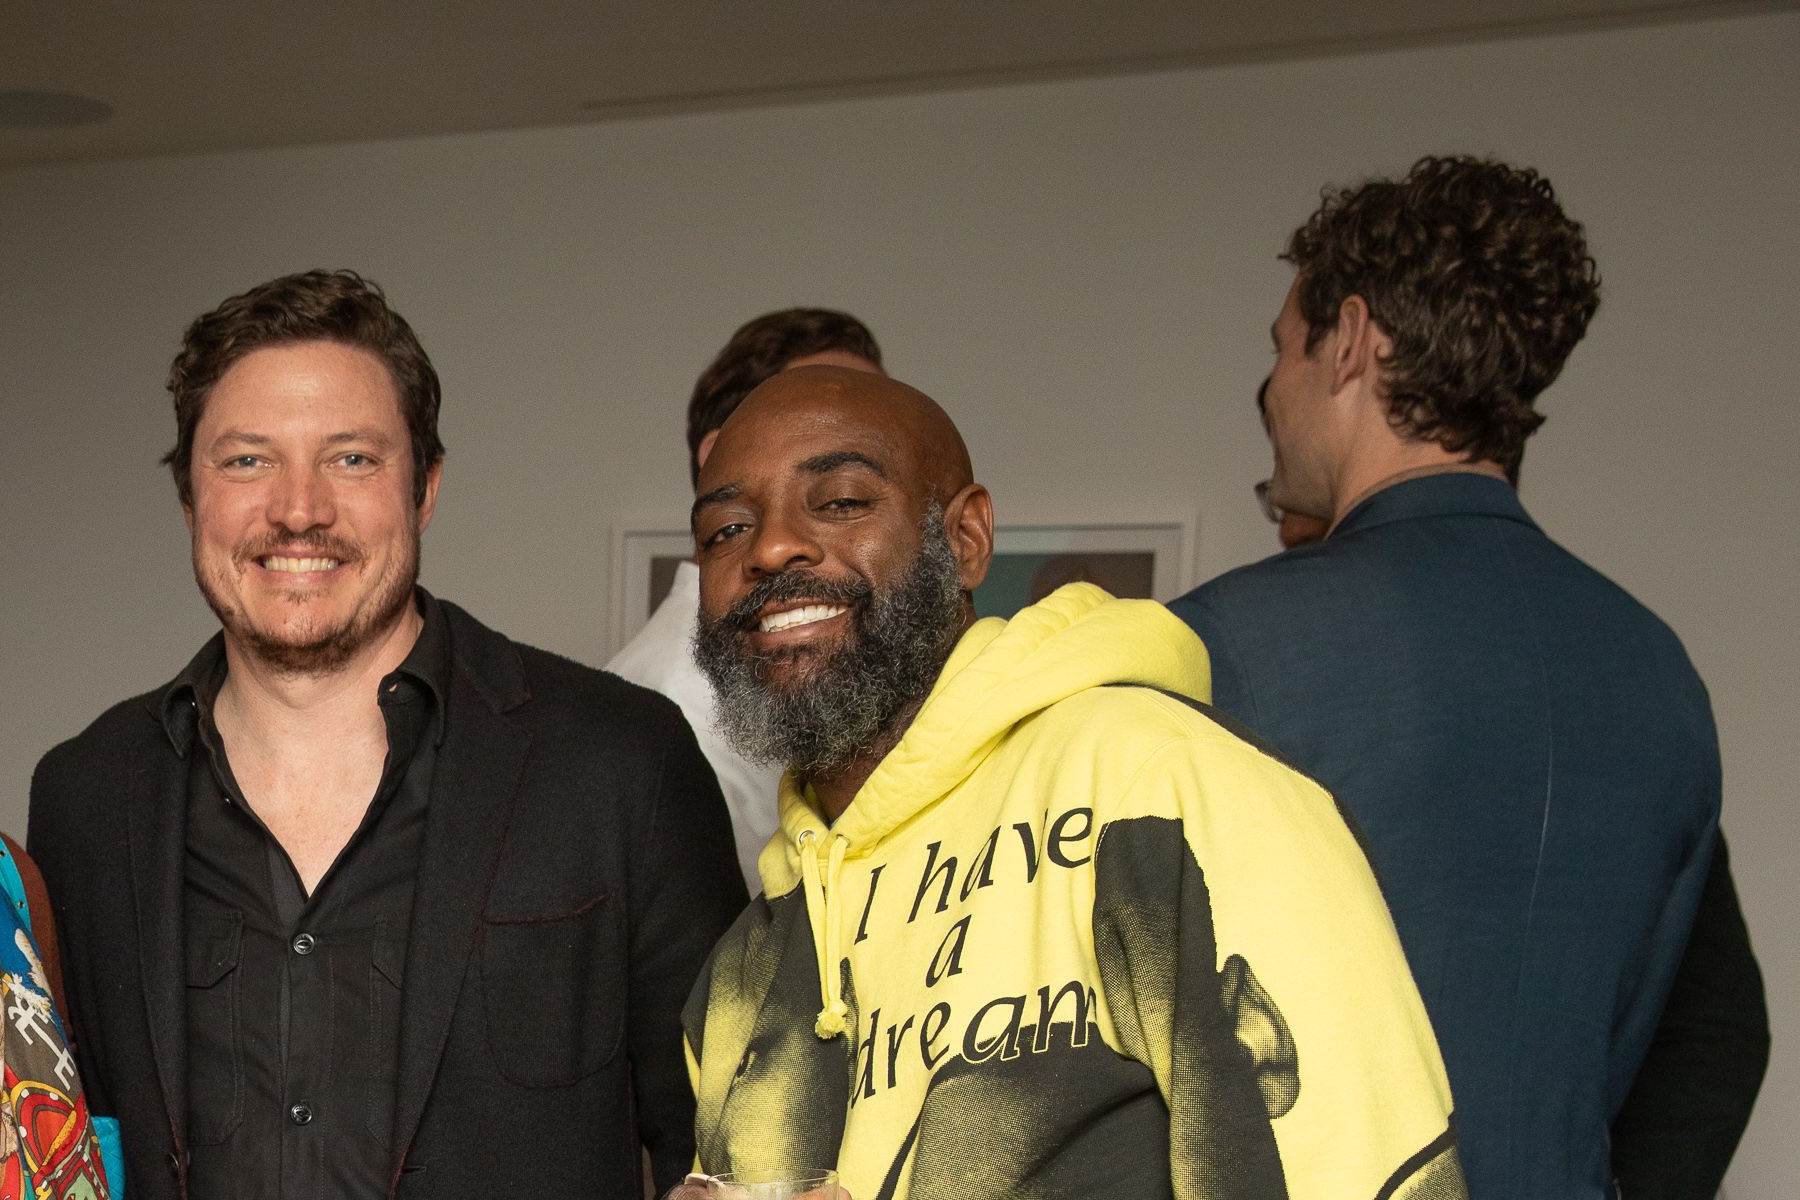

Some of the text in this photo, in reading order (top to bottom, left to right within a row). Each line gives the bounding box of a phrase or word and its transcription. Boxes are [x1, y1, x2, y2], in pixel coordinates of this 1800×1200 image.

[854, 807, 1093, 945] I have
[925, 914, 972, 988] a
[851, 980, 1096, 1109] dream
